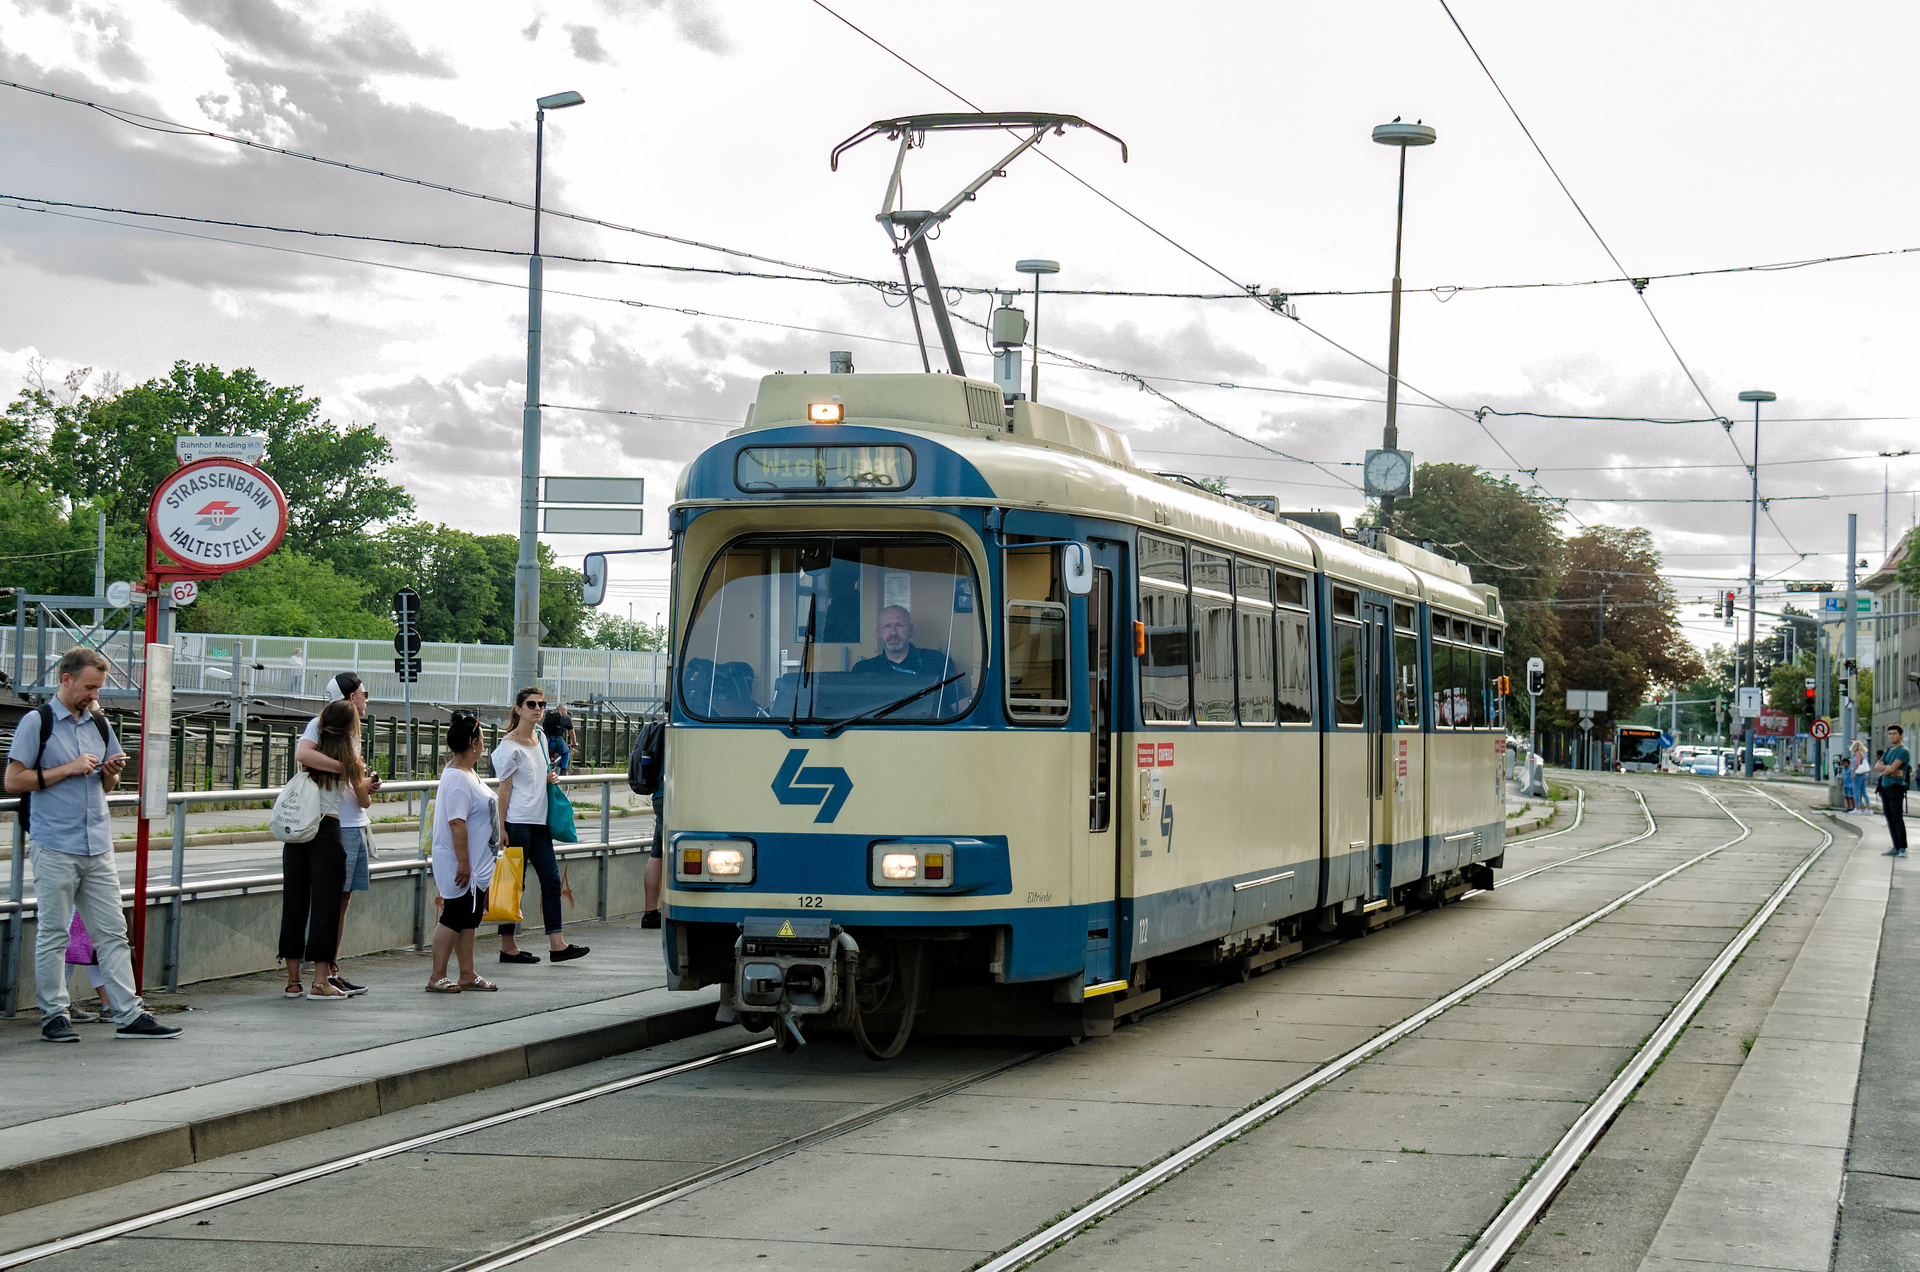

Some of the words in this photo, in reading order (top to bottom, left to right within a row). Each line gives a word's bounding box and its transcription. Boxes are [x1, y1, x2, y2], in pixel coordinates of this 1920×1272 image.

[180, 441, 212, 449] Bahnhof
[214, 441, 247, 450] Meidling
[762, 449, 826, 477] Wien
[166, 472, 272, 510] STRASSENBAHN
[169, 526, 267, 559] HALTESTELLE
[173, 582, 196, 601] 62
[797, 896, 823, 908] 122
[1026, 891, 1052, 904] Elfriede
